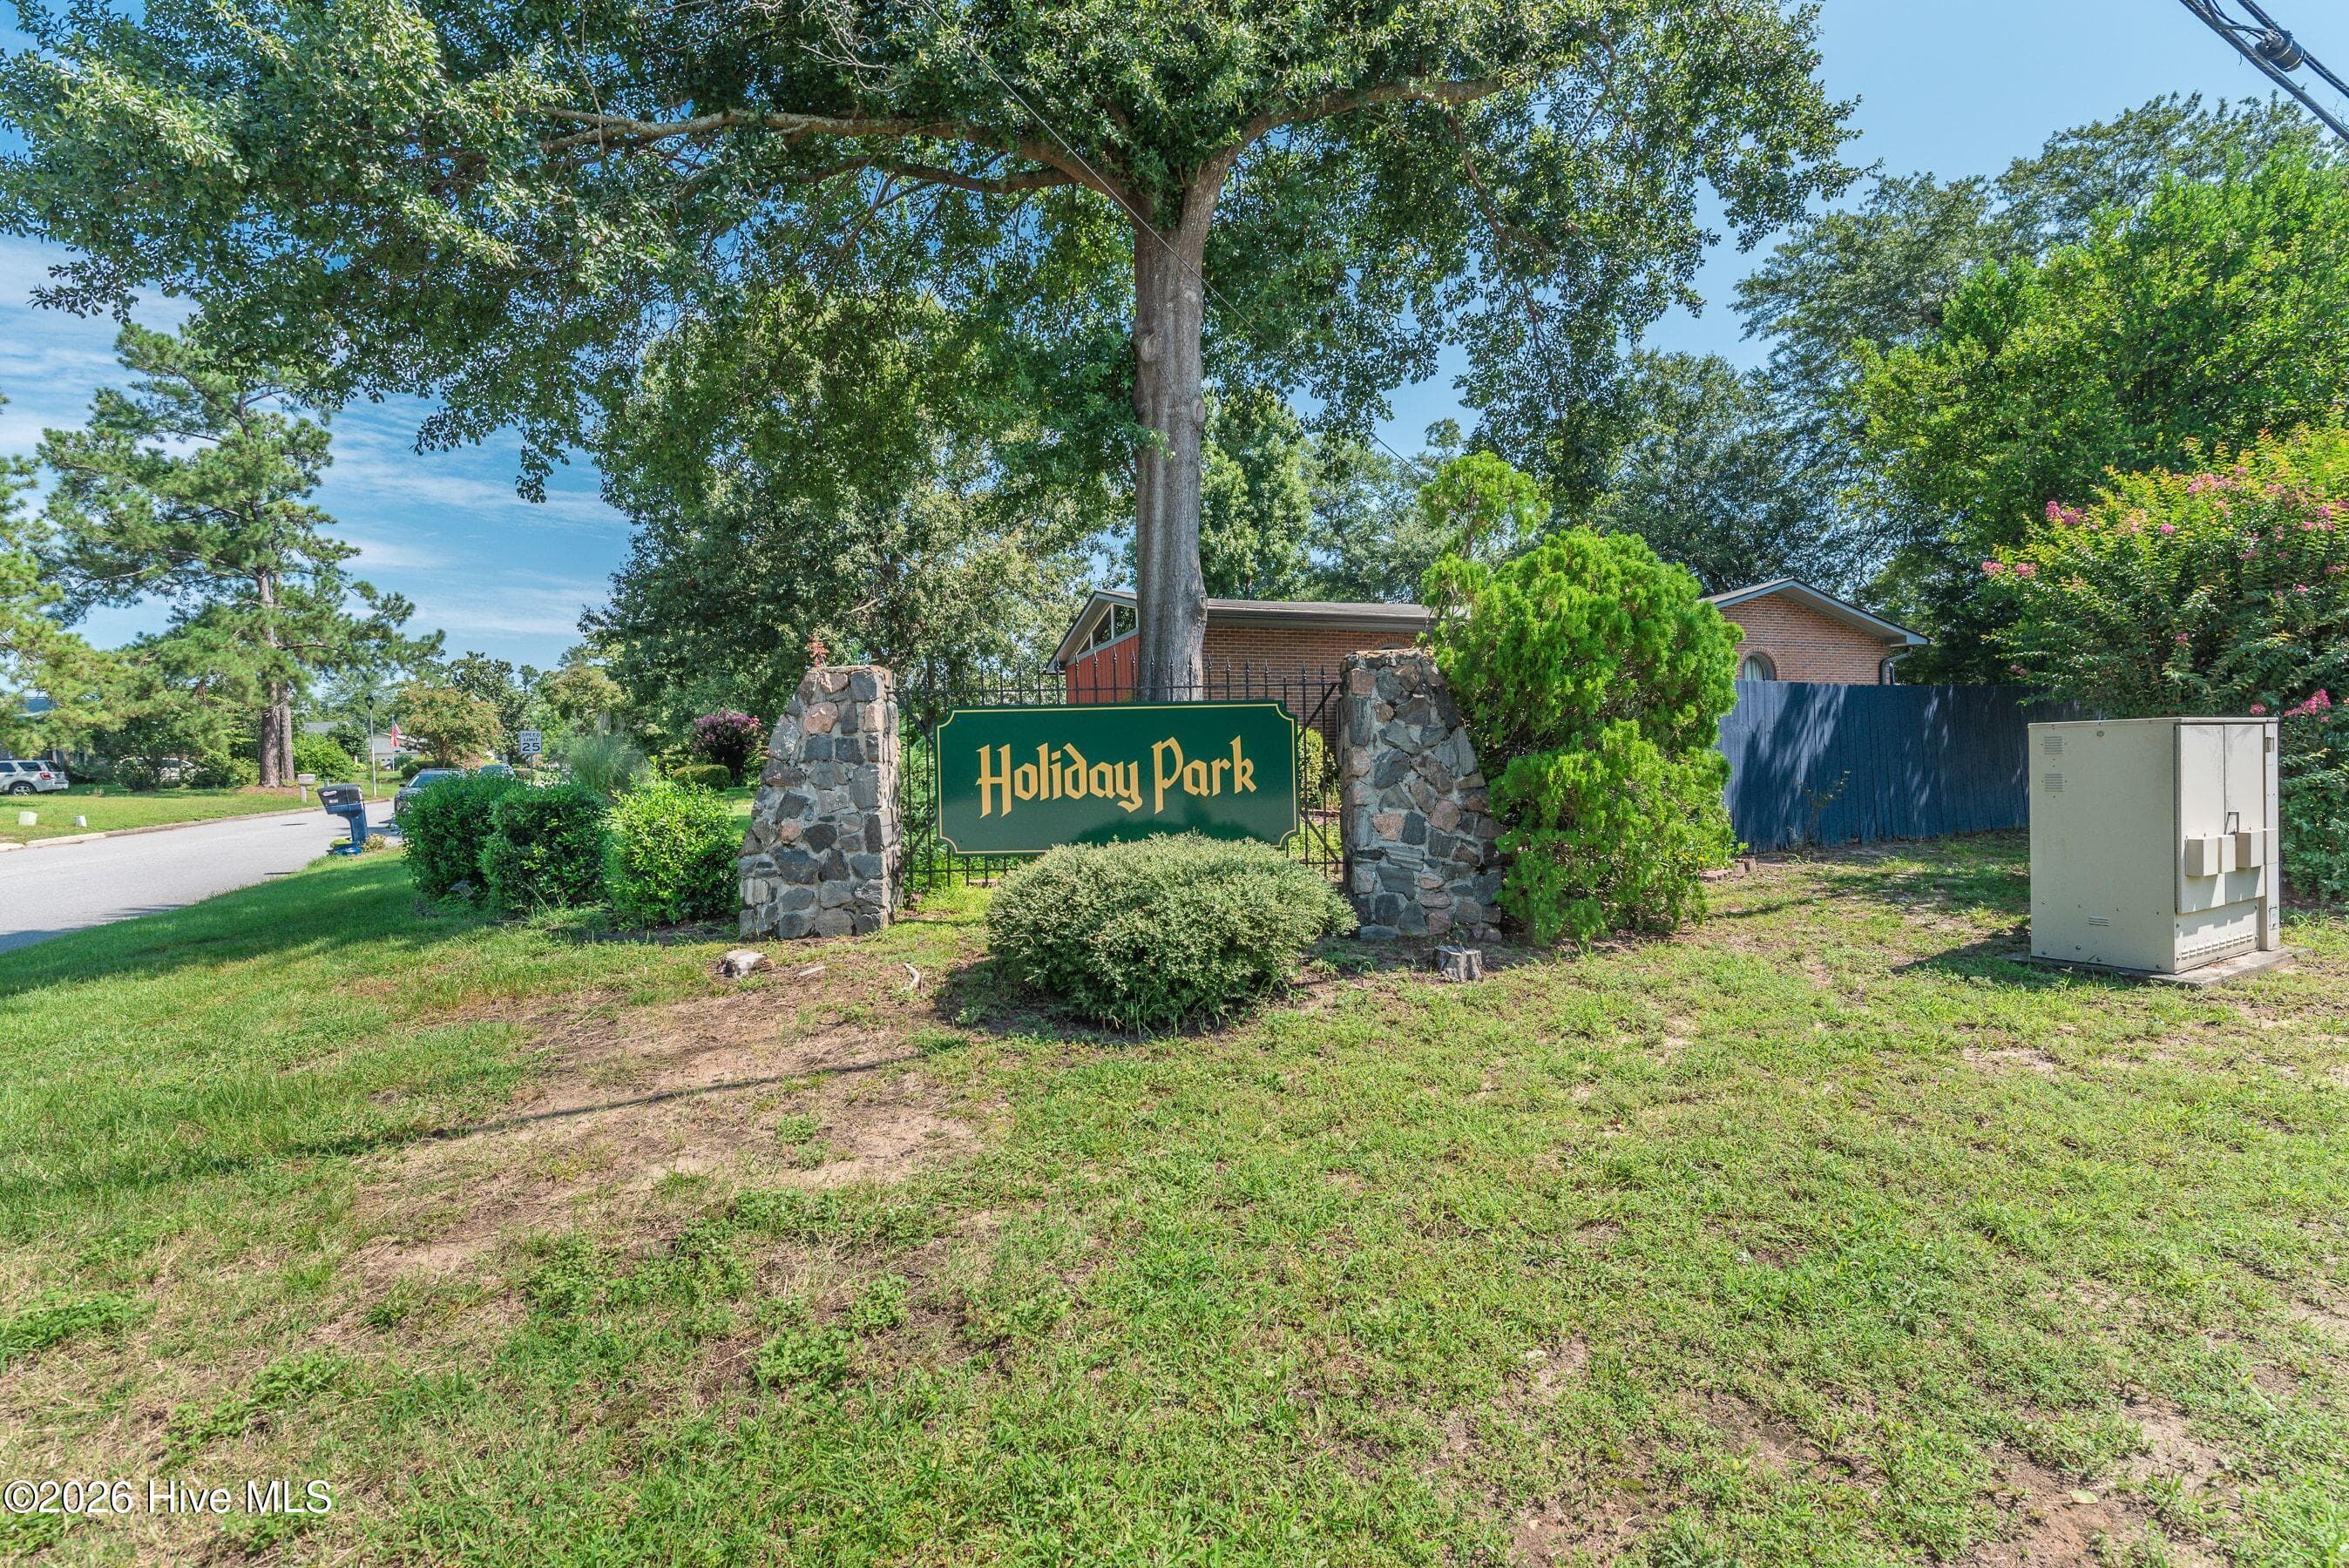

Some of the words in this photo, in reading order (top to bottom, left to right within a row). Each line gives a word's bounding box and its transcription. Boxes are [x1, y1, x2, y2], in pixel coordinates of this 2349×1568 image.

[522, 742, 540, 752] 25
[976, 742, 1143, 819] Holiday
[1151, 734, 1257, 814] Park
